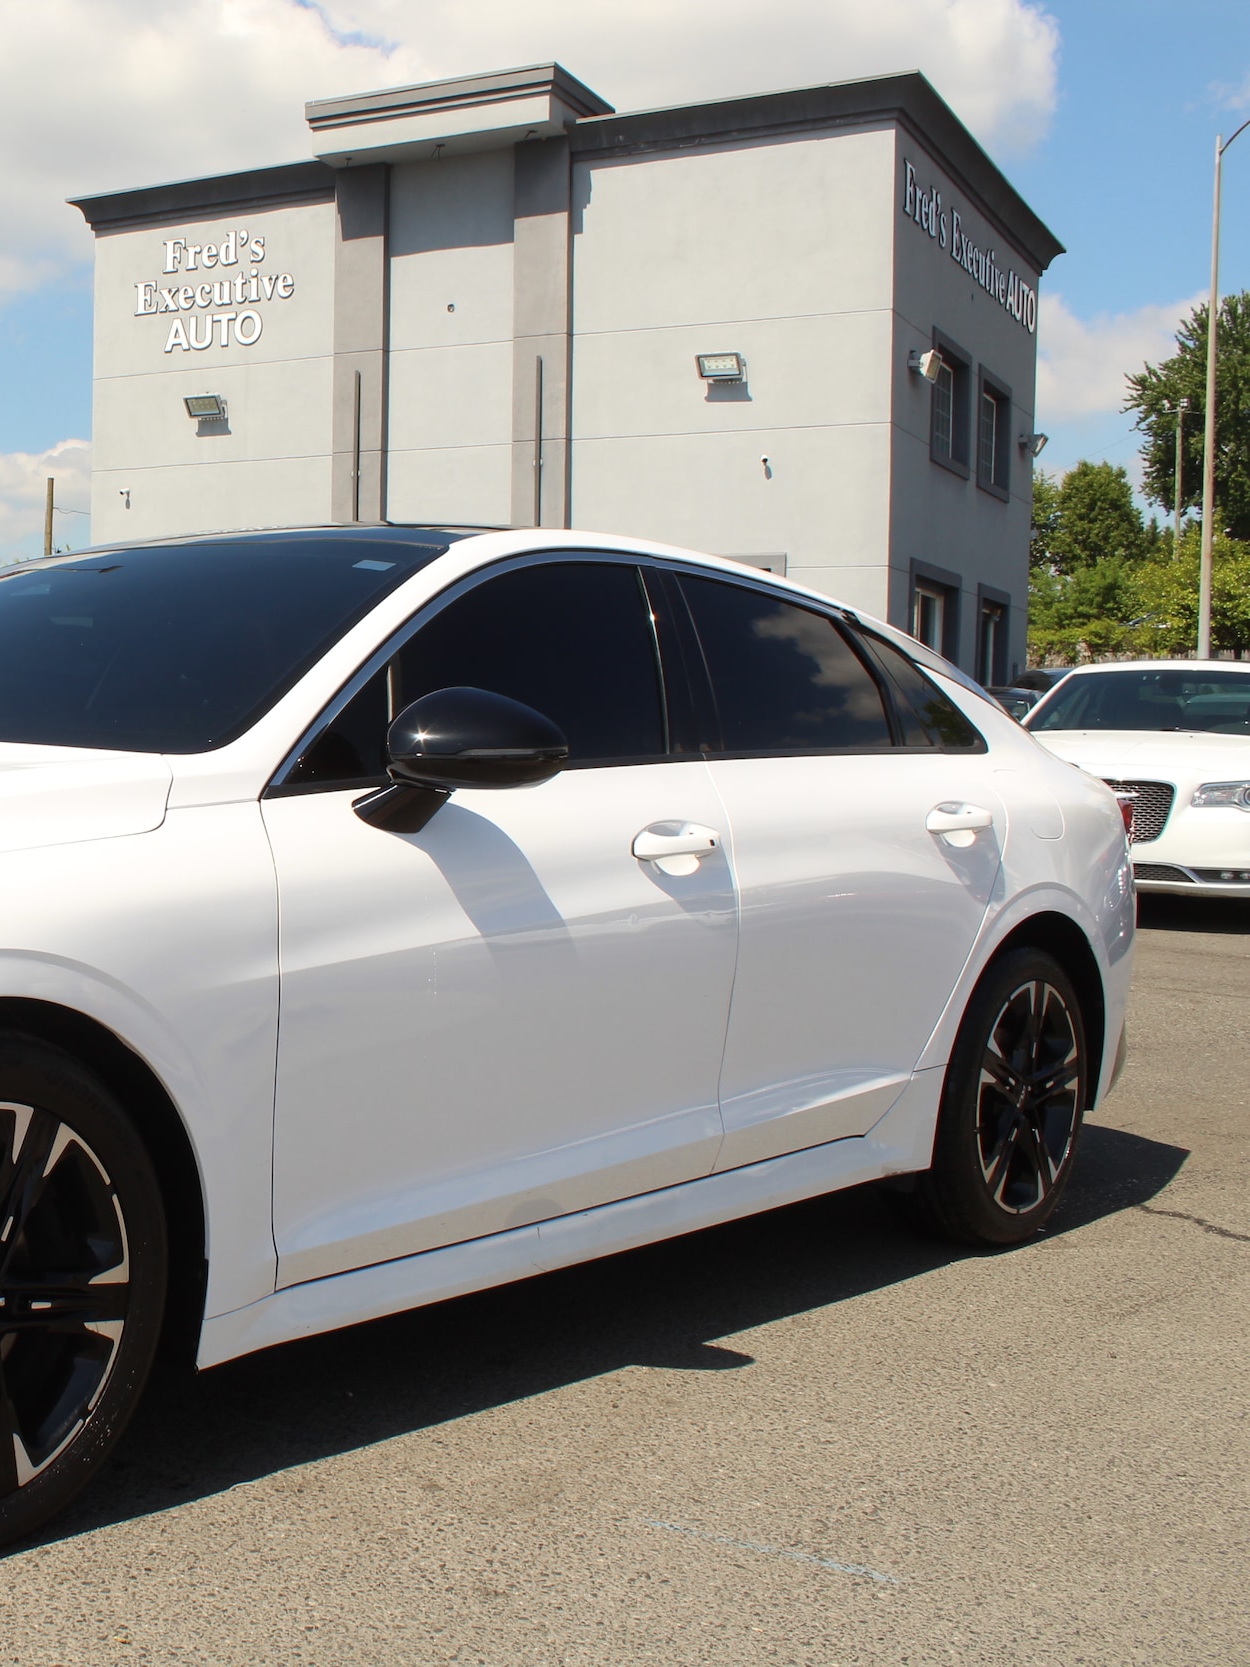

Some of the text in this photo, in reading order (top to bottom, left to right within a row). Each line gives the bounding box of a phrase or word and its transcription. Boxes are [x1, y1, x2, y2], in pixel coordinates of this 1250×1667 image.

[162, 229, 266, 275] Fred's
[904, 157, 1037, 335] Fred's Executive AUTO
[134, 267, 295, 317] Executive
[164, 309, 264, 354] AUTO
